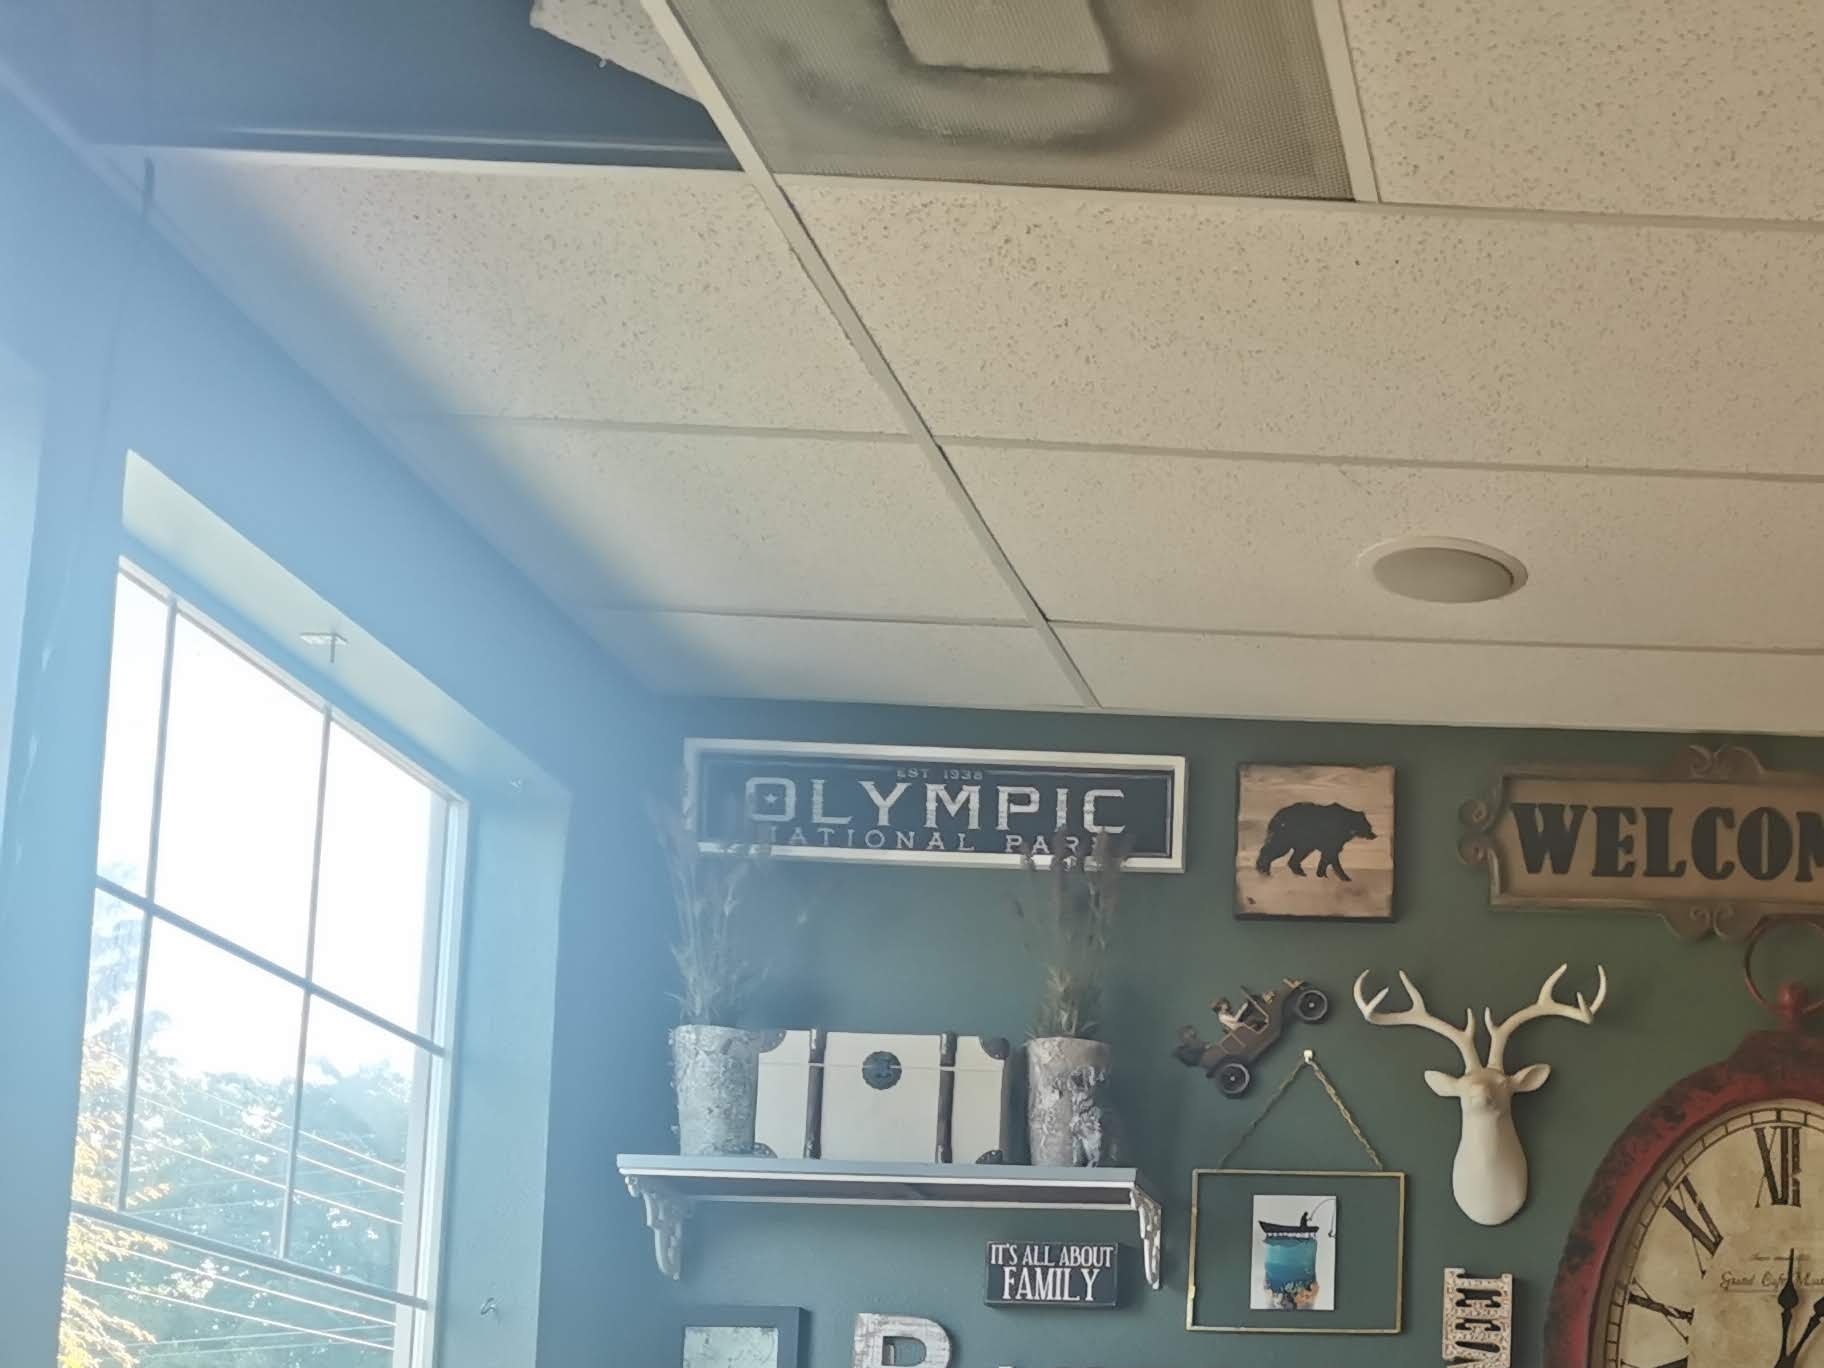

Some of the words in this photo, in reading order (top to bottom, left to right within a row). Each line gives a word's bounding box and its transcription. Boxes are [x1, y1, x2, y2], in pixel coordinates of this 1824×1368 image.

[896, 768, 930, 780] EST
[943, 769, 984, 781] 1938
[745, 775, 1126, 834] OLYMPIC
[991, 1244, 1018, 1265] IT'S
[1022, 1245, 1055, 1266] ALL
[1059, 1246, 1114, 1267] ABOUT
[1002, 1266, 1101, 1301] FAMILY
